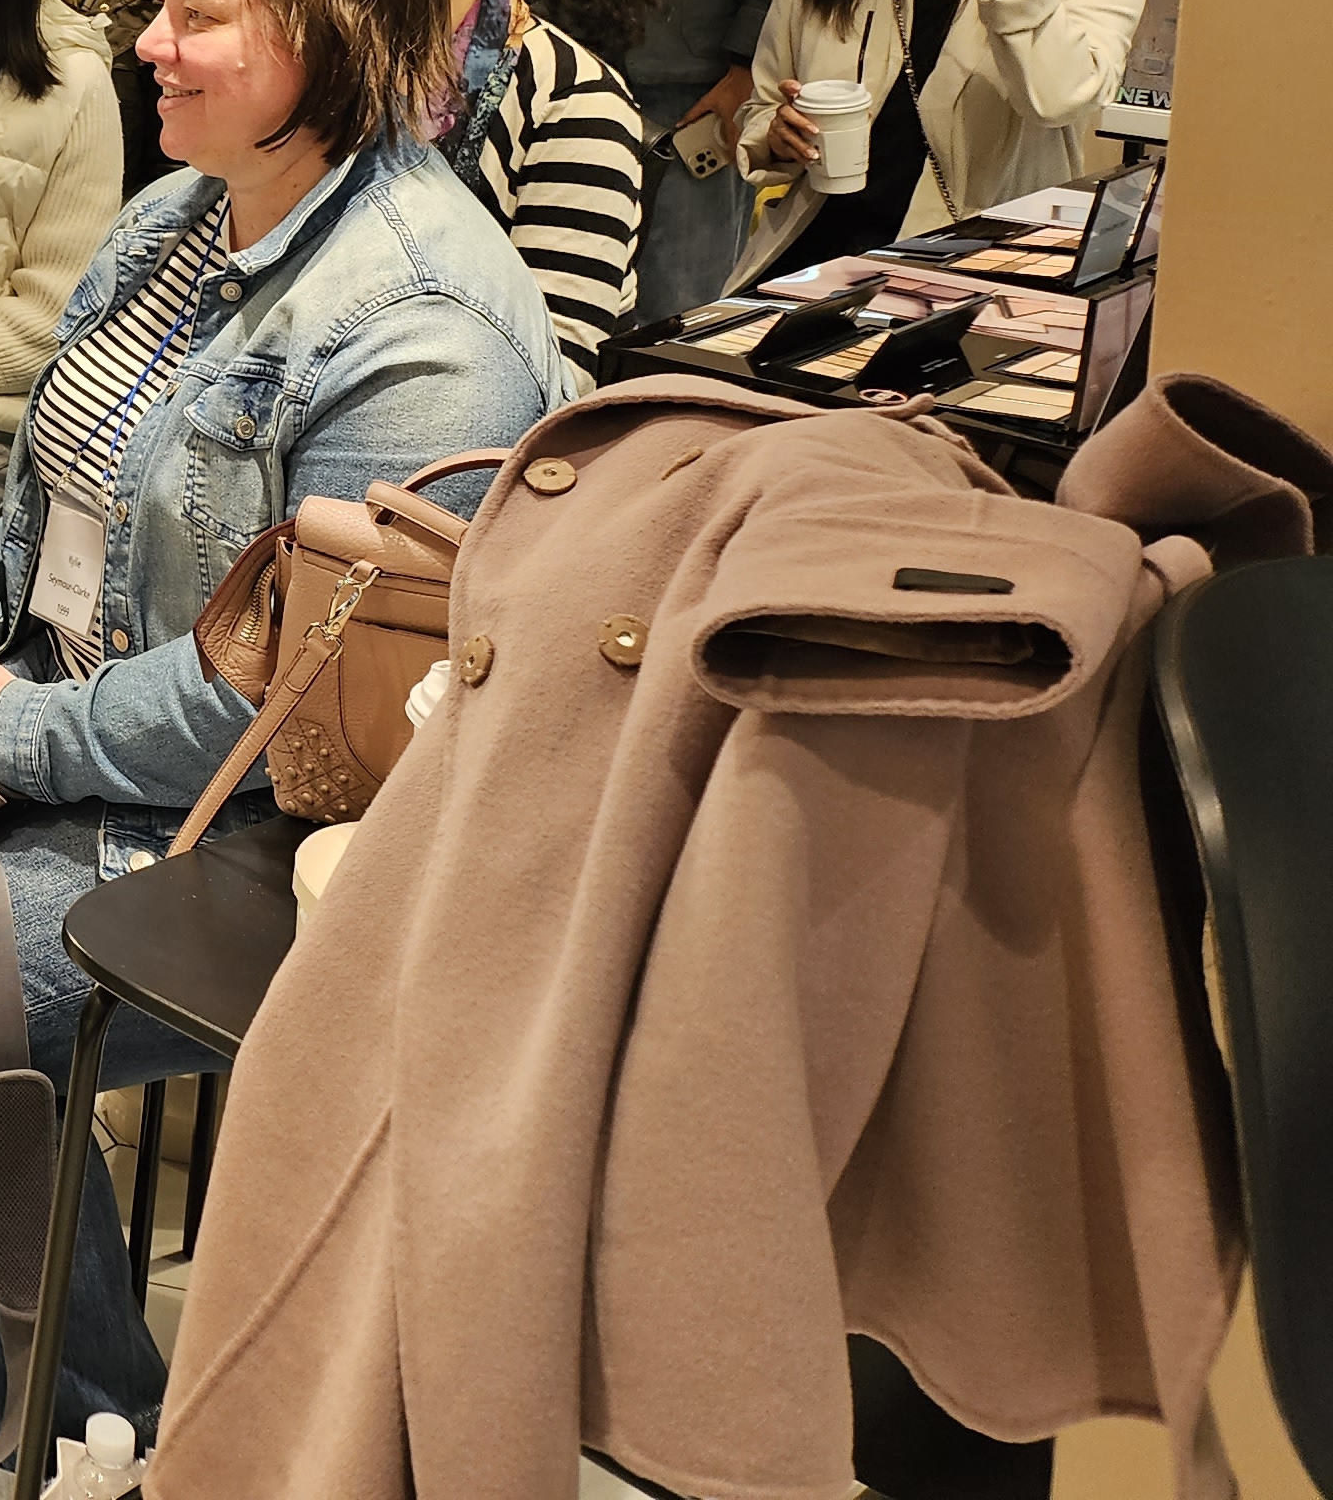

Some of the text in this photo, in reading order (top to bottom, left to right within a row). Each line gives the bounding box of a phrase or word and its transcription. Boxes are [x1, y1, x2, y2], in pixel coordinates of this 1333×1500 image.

[1115, 86, 1171, 109] NEW
[68, 555, 82, 569] Kylie
[47, 572, 90, 600] Seymour-Clarke
[57, 604, 70, 617] 1999
